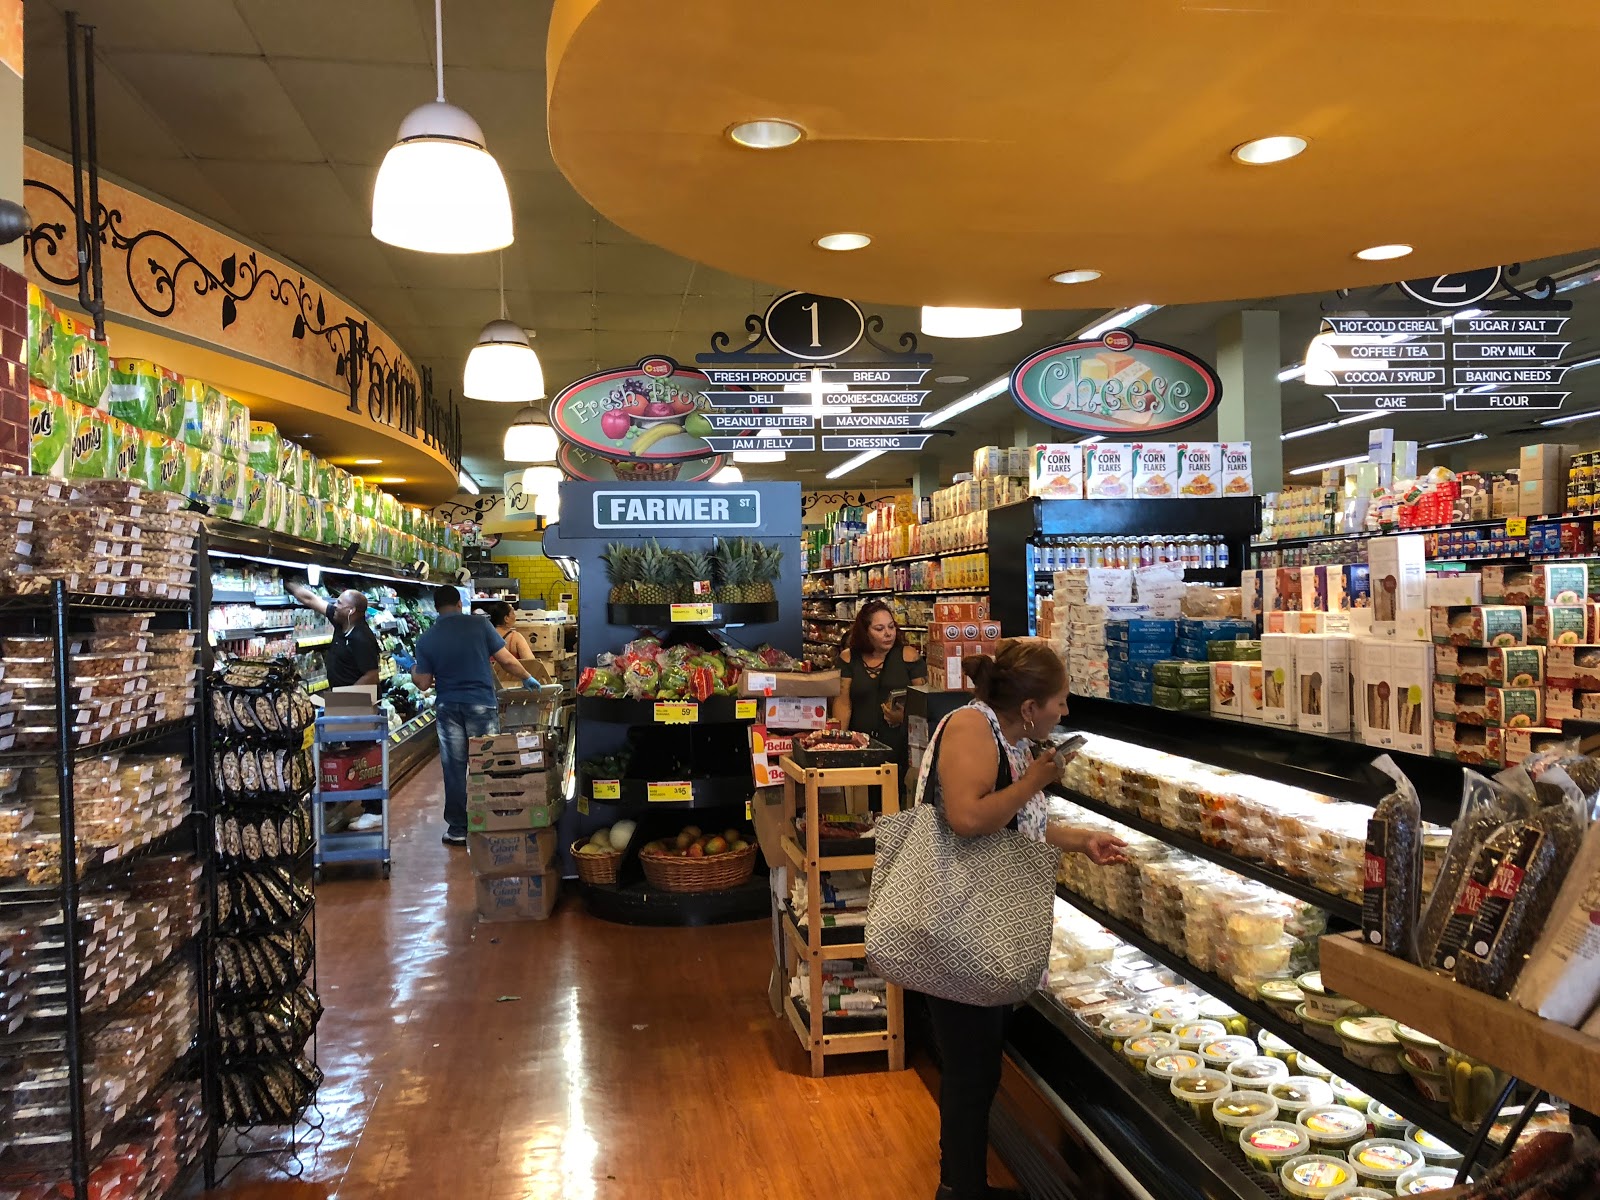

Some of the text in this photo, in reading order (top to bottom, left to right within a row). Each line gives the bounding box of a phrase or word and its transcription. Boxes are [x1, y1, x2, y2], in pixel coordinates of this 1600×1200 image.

[801, 301, 822, 347] 1
[1339, 321, 1439, 332] HOT-COLD CEREAL
[1469, 320, 1546, 331] SUGAR / SALT
[1350, 346, 1429, 357] COFFEE / TEA
[1481, 346, 1536, 356] DRY MILK
[714, 371, 807, 382] FRESH PRODUCE
[853, 371, 891, 381] BREAD
[1344, 371, 1436, 383] COCOA / SYRUP
[1466, 371, 1551, 381] BAKING NEEDS
[1038, 355, 1192, 414] Cheese
[568, 383, 639, 424] Fresh
[749, 394, 774, 404] DELI
[826, 393, 918, 404] COOKIES-CRACKERS
[1375, 397, 1407, 408] CAKE
[1489, 396, 1529, 406] FLOUR
[716, 417, 808, 427] PEANUT BUTTER
[836, 415, 910, 426] MAYONNAISE
[732, 439, 793, 449] JAM / JELLY
[847, 437, 900, 448] DRESSING
[1047, 455, 1071, 464] CORN
[1098, 454, 1121, 463] CORN
[1143, 453, 1166, 463] CORN
[1188, 453, 1211, 463] CORN
[1227, 455, 1247, 464] CORN
[1048, 464, 1072, 472] FLAKES
[1098, 464, 1122, 472] FLAKES
[1143, 463, 1166, 471] FLAKES
[1189, 463, 1211, 471] FLAKES
[1227, 463, 1248, 471] FLAKES
[610, 498, 751, 521] FARMER ST
[766, 741, 793, 751] Bella
